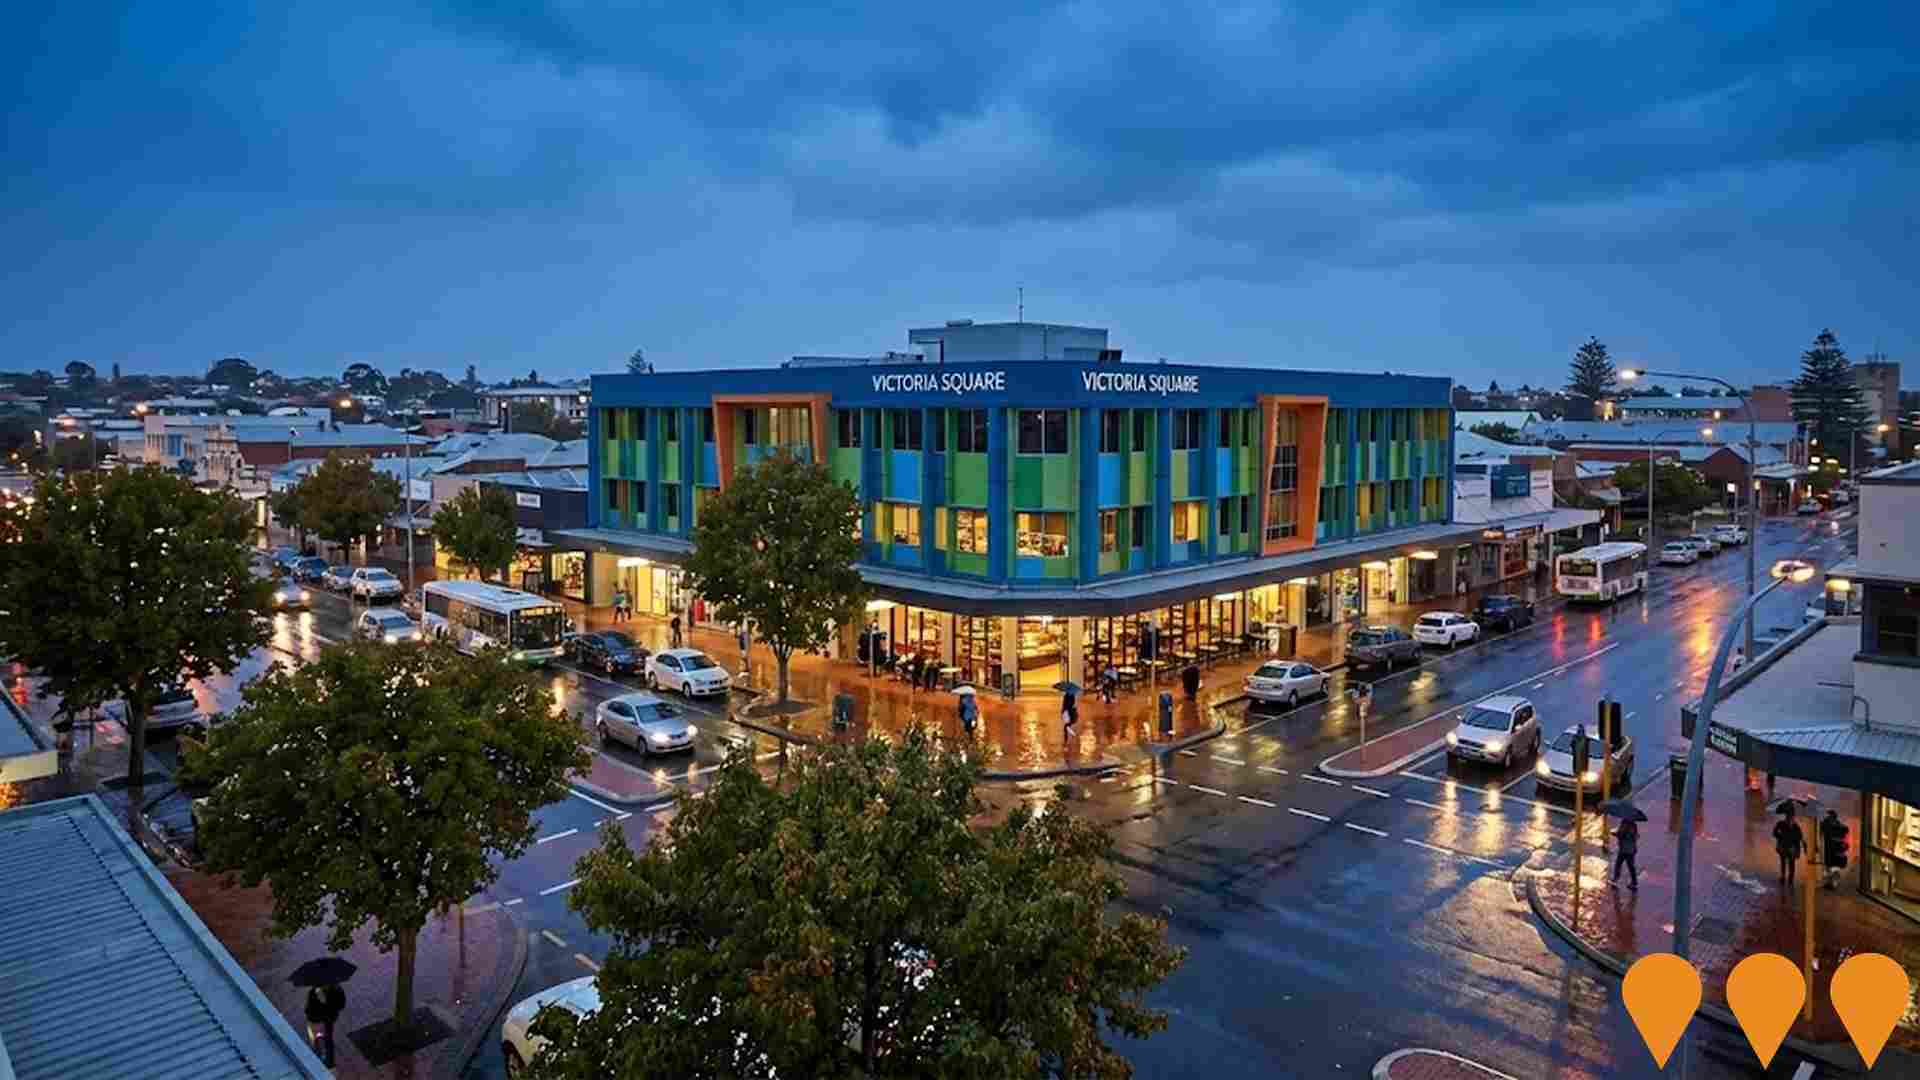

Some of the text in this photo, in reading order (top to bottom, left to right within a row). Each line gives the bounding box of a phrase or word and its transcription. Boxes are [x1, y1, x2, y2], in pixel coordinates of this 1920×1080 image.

[872, 372, 1005, 394] VICTORIA SQUARE
[1081, 371, 1147, 392] VICTORIA
